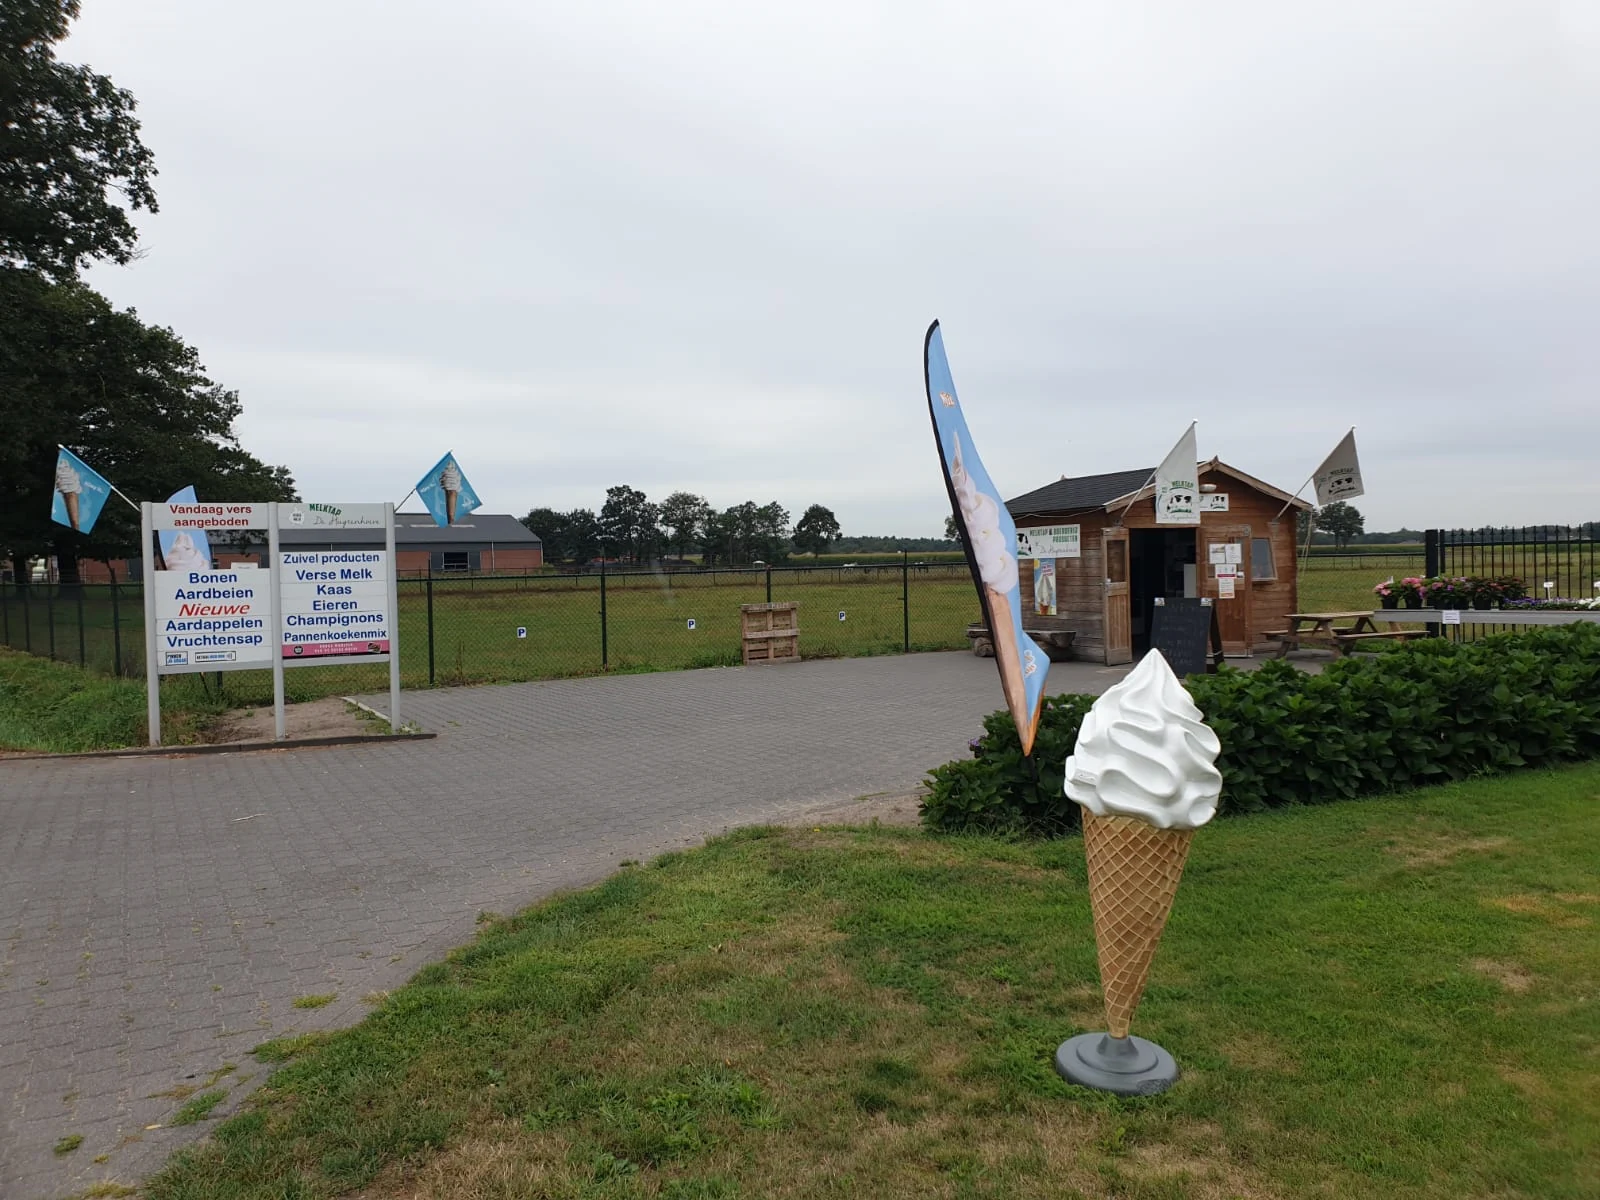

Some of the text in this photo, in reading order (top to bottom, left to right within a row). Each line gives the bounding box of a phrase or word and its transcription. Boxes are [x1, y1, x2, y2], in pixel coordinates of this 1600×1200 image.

[170, 504, 252, 515] Vandaag vers
[309, 503, 342, 516] MELKTAP
[174, 517, 249, 528] aangeboden
[283, 553, 380, 565] Zuivel producten
[189, 572, 238, 584] Bonen
[296, 568, 373, 580] Verse Melk
[175, 587, 253, 600] Aardbeien
[317, 584, 352, 595] Kaas
[179, 603, 250, 616] Nieuwe
[313, 600, 358, 611] Eieren
[166, 617, 263, 632] Aardappelen
[287, 613, 383, 627] Champignons
[689, 620, 694, 628] P
[167, 634, 263, 648] Vruchtensap
[284, 628, 387, 642] Pannenkoekenmix
